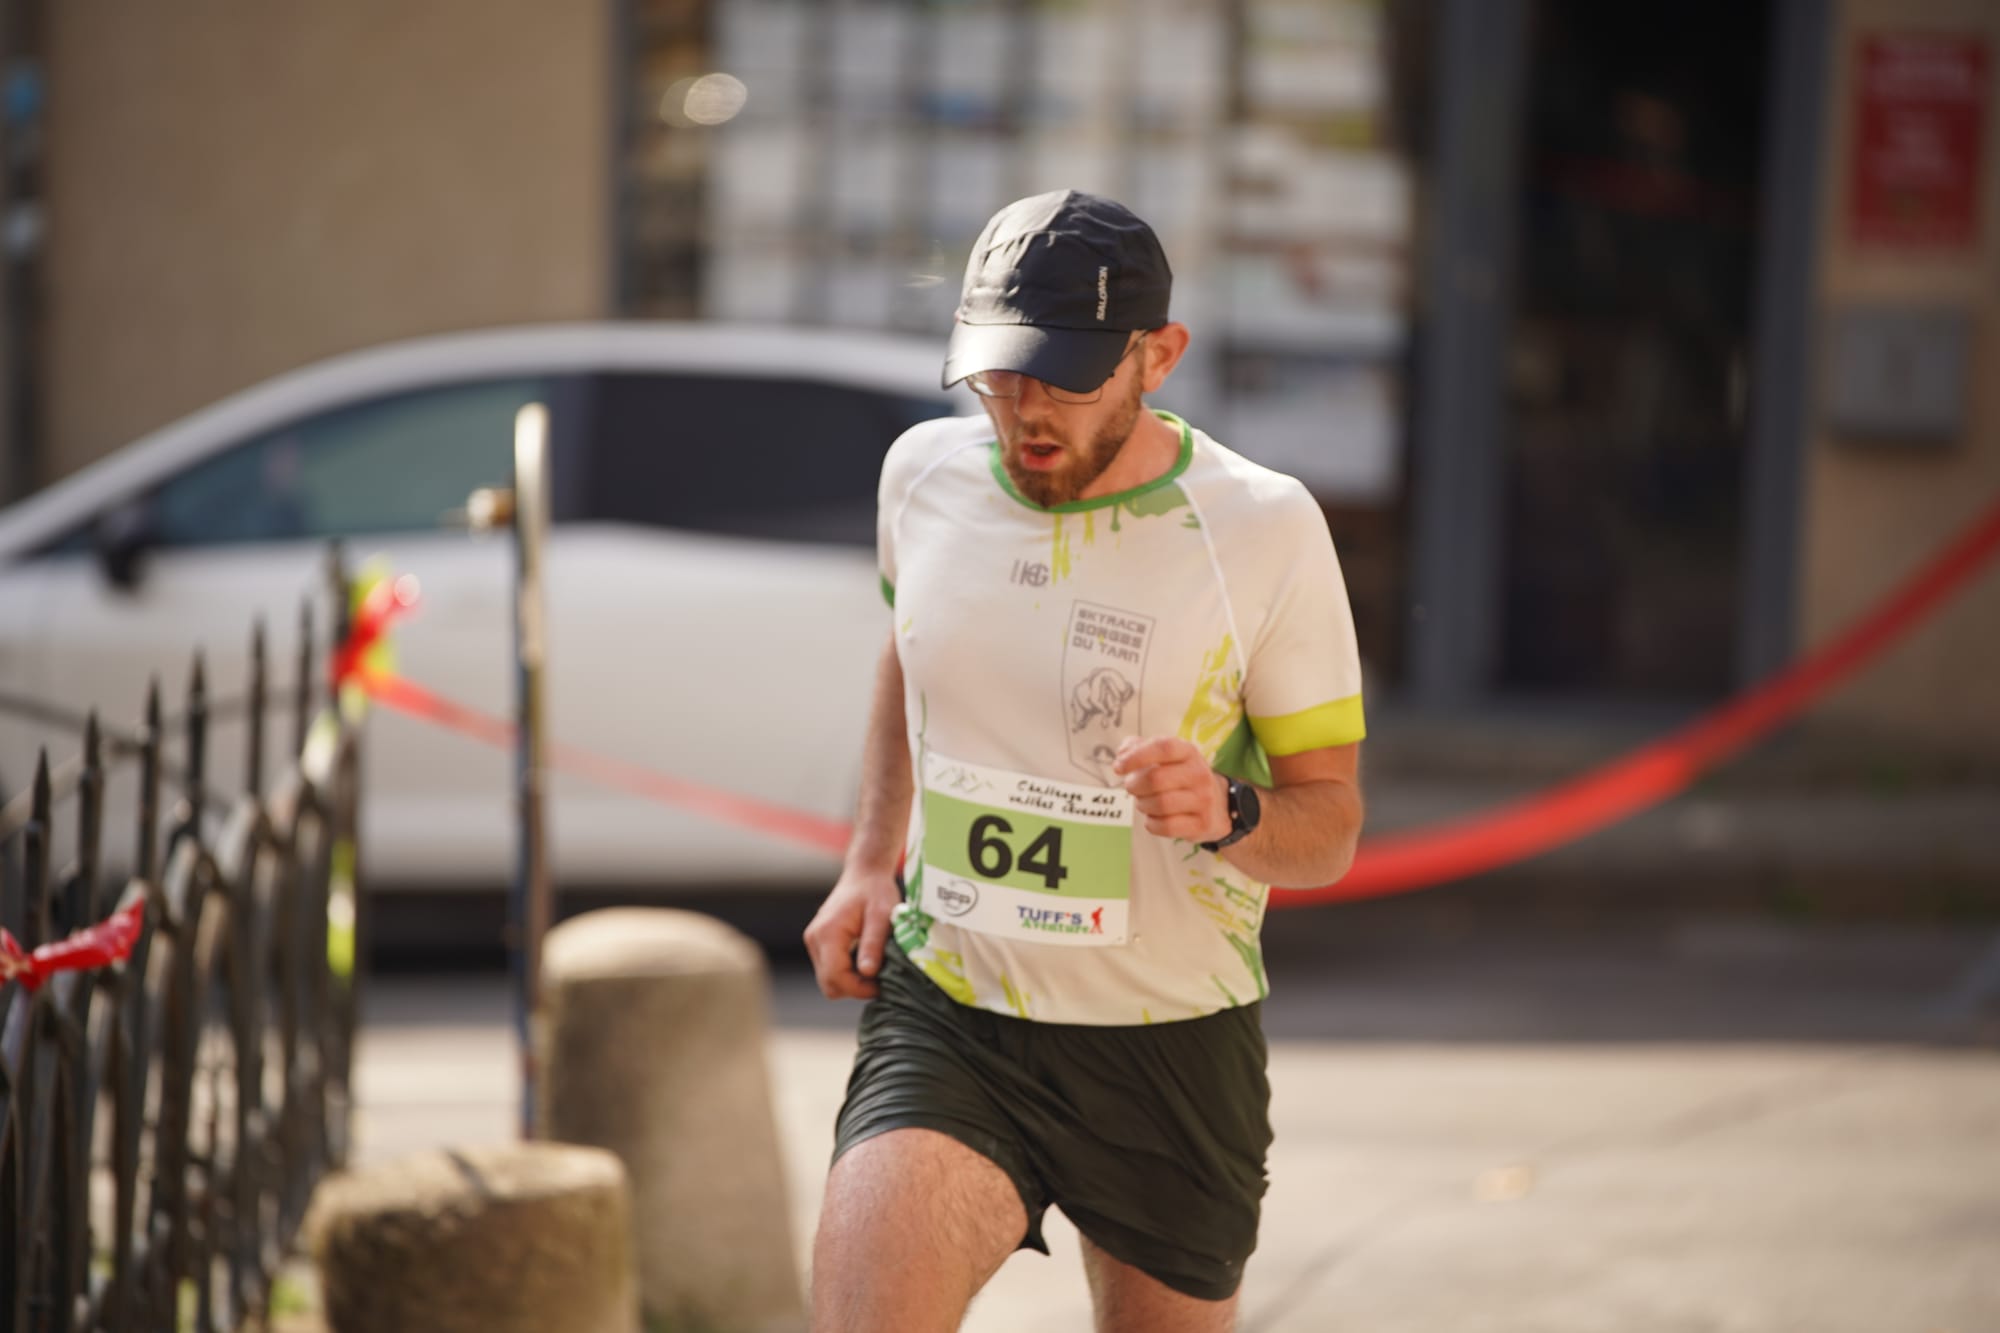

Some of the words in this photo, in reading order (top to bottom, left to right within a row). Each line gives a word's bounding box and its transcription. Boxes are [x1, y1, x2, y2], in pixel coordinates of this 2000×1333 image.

[1096, 266, 1109, 320] SALOMON
[1078, 609, 1146, 634] SKYRACE
[1072, 635, 1093, 650] DU
[1075, 621, 1143, 649] GORGES
[1017, 780, 1082, 803] Challenge
[1092, 794, 1115, 804] des
[968, 814, 1068, 889] 64
[1017, 905, 1082, 925] TUFF'S
